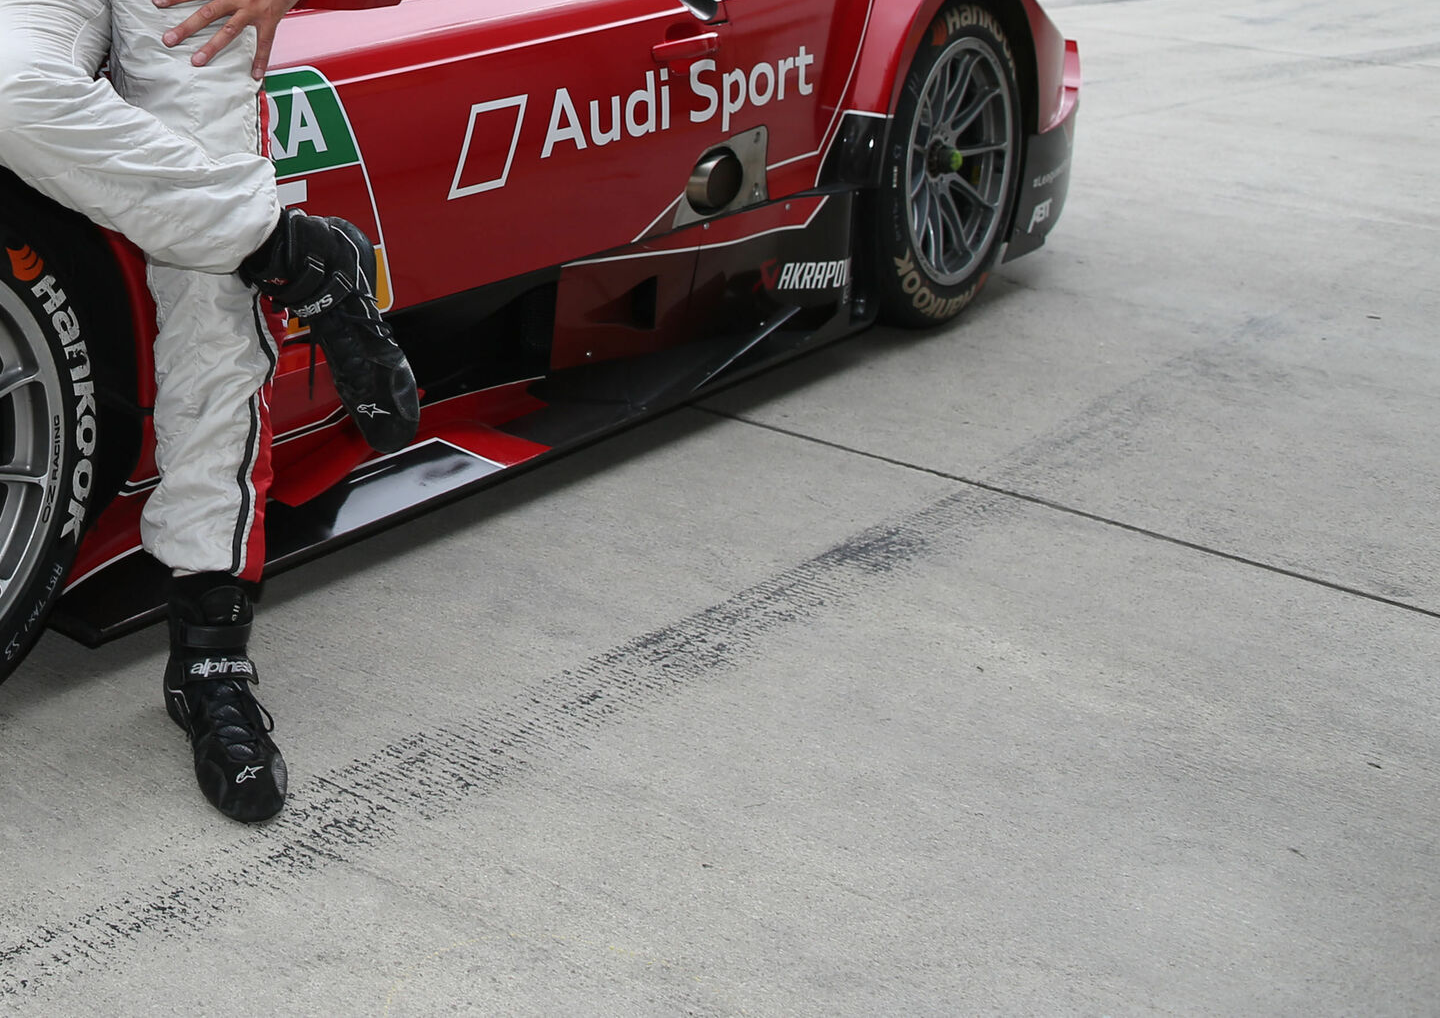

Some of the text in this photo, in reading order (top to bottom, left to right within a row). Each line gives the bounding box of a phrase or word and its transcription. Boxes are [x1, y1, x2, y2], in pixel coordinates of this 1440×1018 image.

[540, 45, 815, 159] Audi Sport
[777, 258, 851, 290] AKRAPO
[51, 415, 61, 481] RACING
